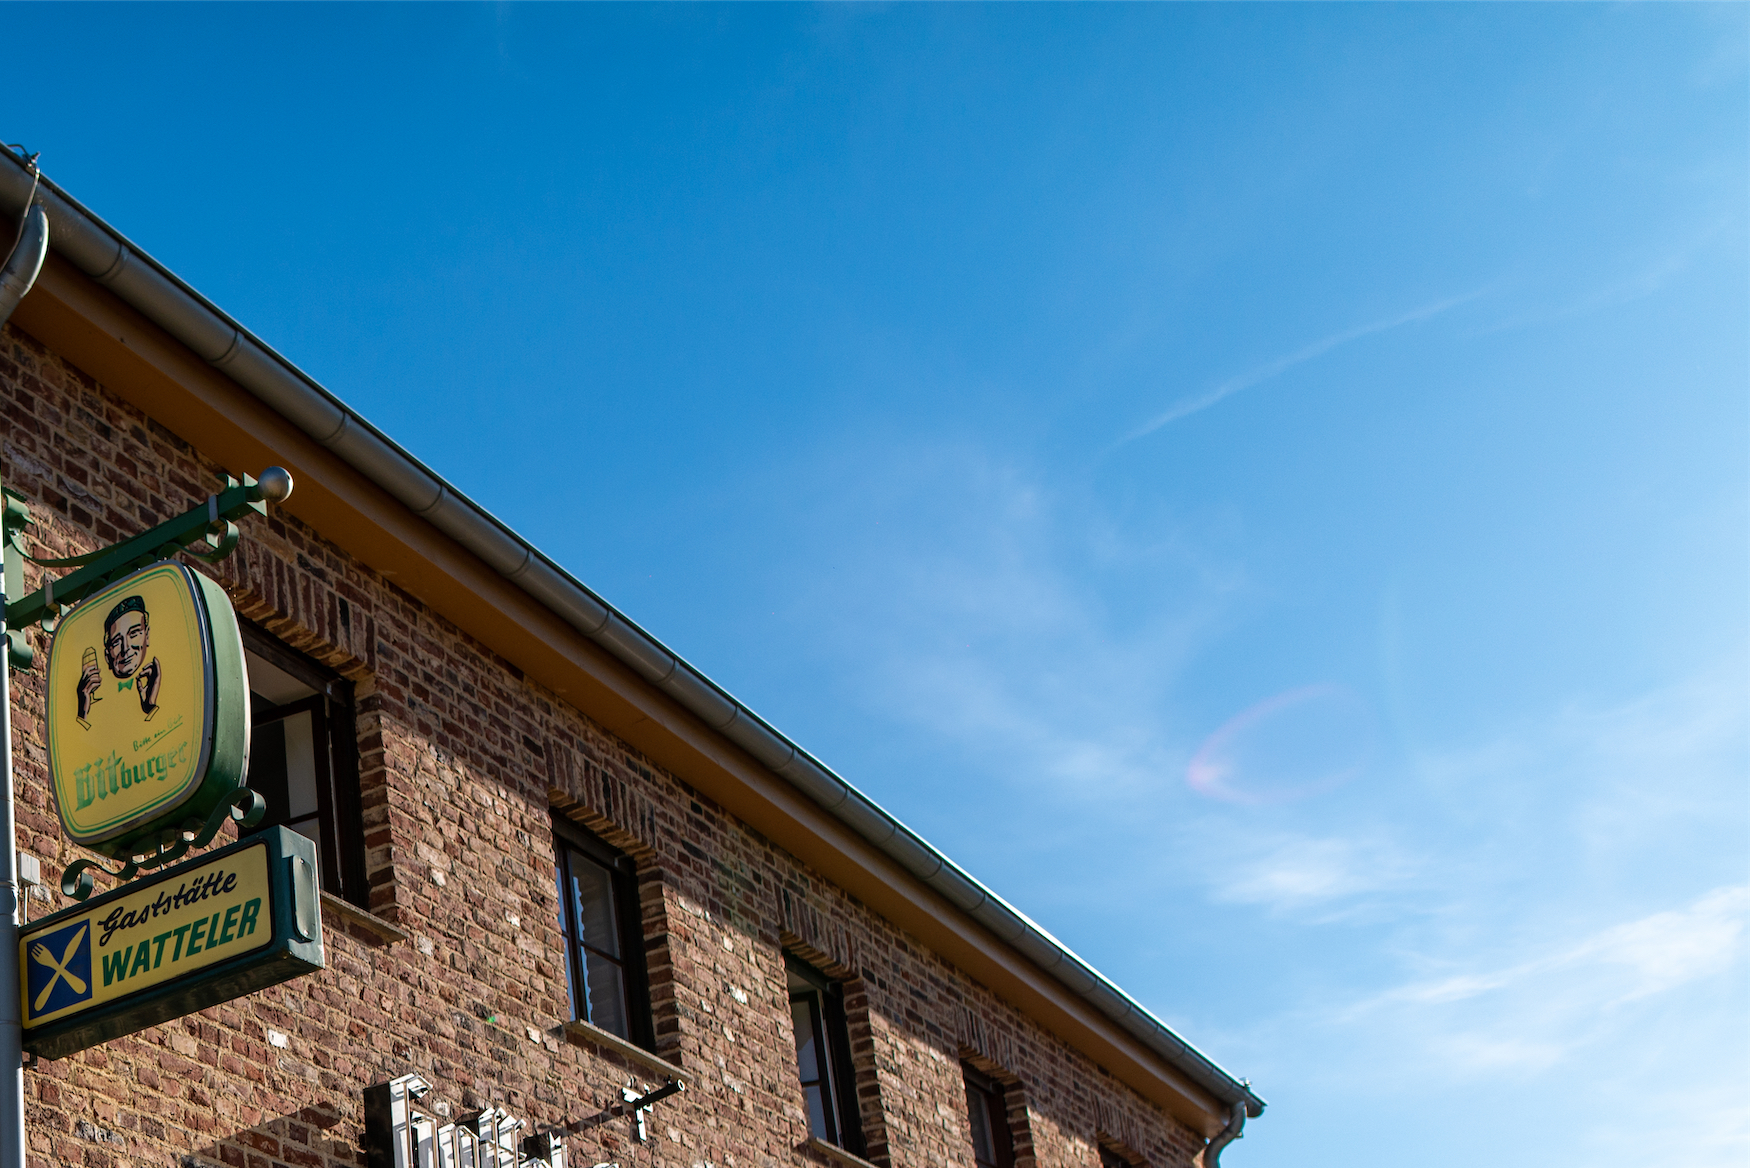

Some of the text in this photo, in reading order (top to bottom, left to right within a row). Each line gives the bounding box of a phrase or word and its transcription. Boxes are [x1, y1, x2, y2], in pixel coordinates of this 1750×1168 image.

[73, 741, 187, 812] Bitburger
[97, 870, 238, 947] Gaststätte
[102, 897, 262, 987] WATTELER
